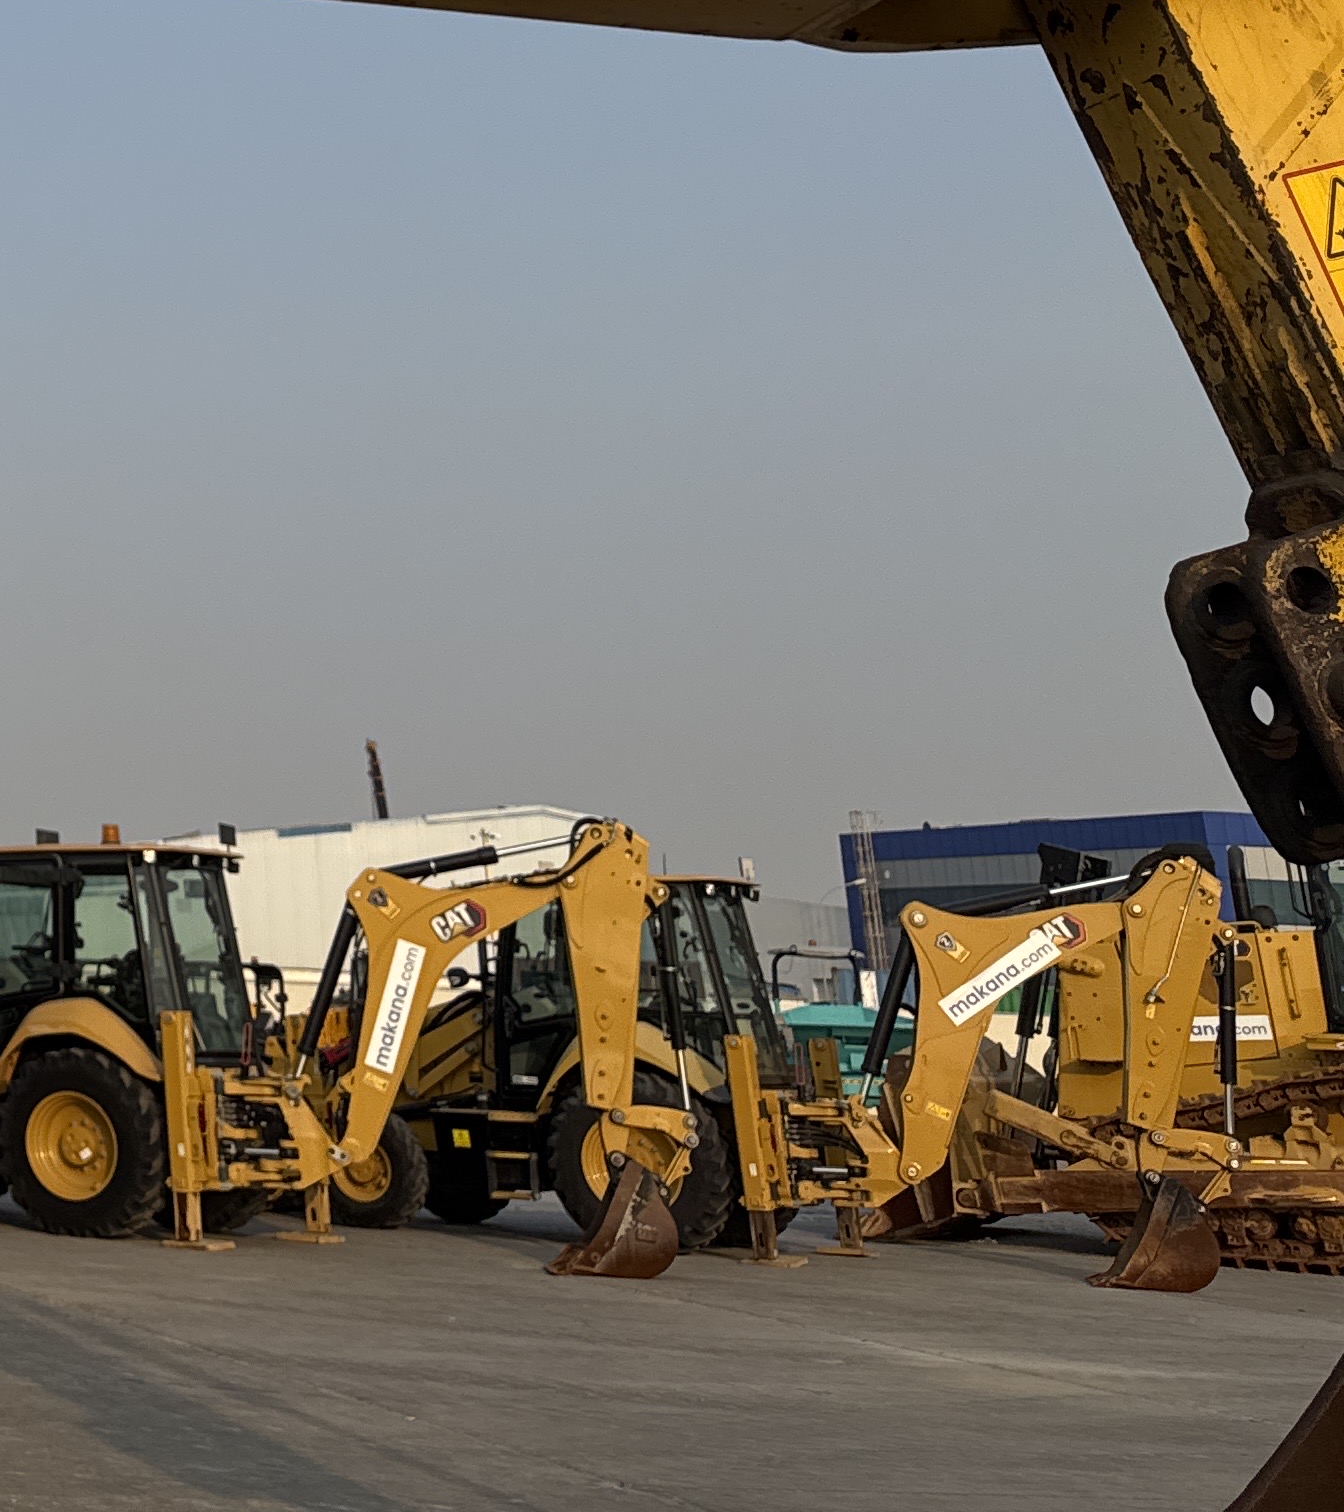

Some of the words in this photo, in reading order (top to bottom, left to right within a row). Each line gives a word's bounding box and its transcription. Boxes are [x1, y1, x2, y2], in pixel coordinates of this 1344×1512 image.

[431, 903, 475, 942] CAT
[375, 945, 420, 1068] makana.com
[947, 942, 1054, 1019] makana.com
